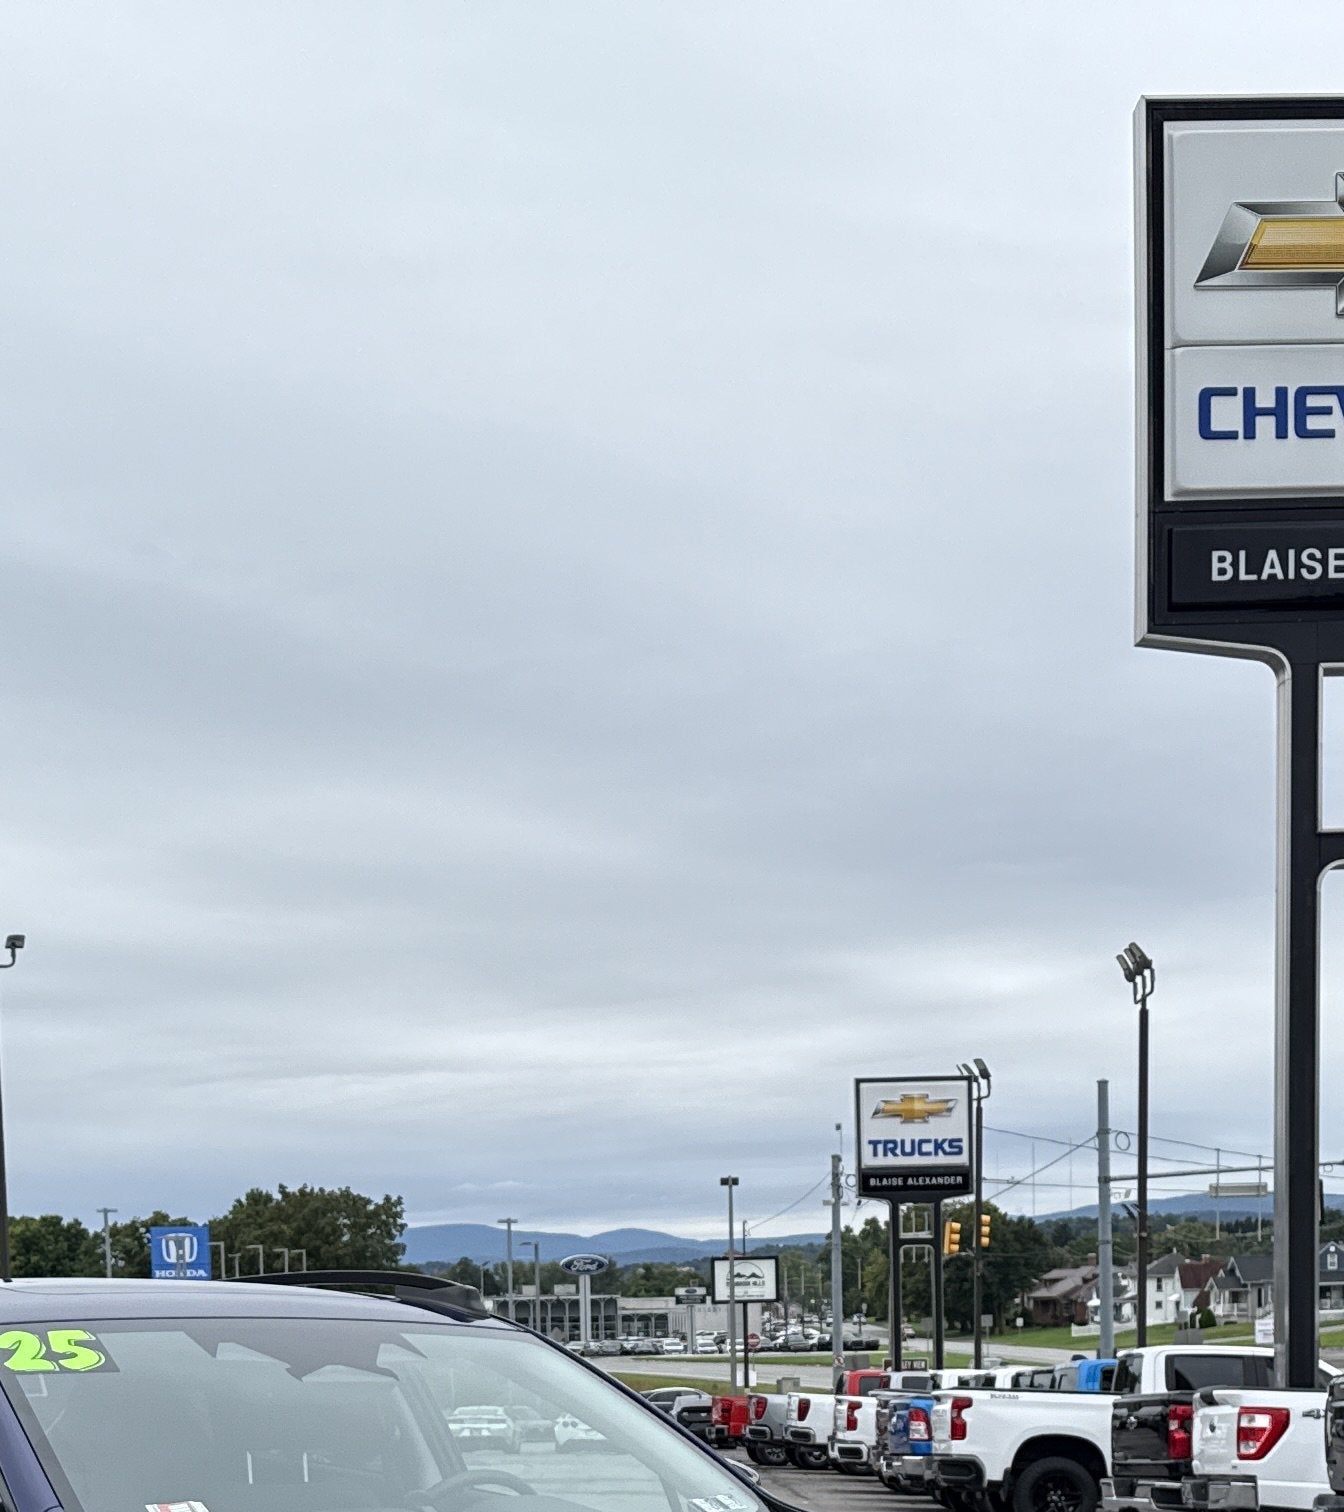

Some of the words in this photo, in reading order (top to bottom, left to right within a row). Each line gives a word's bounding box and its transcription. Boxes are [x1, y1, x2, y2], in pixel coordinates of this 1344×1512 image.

[867, 1138, 963, 1157] TRUCKS
[869, 1177, 904, 1186] BLAISE
[906, 1175, 963, 1186] ALEXANDER
[155, 1269, 208, 1278] HODA
